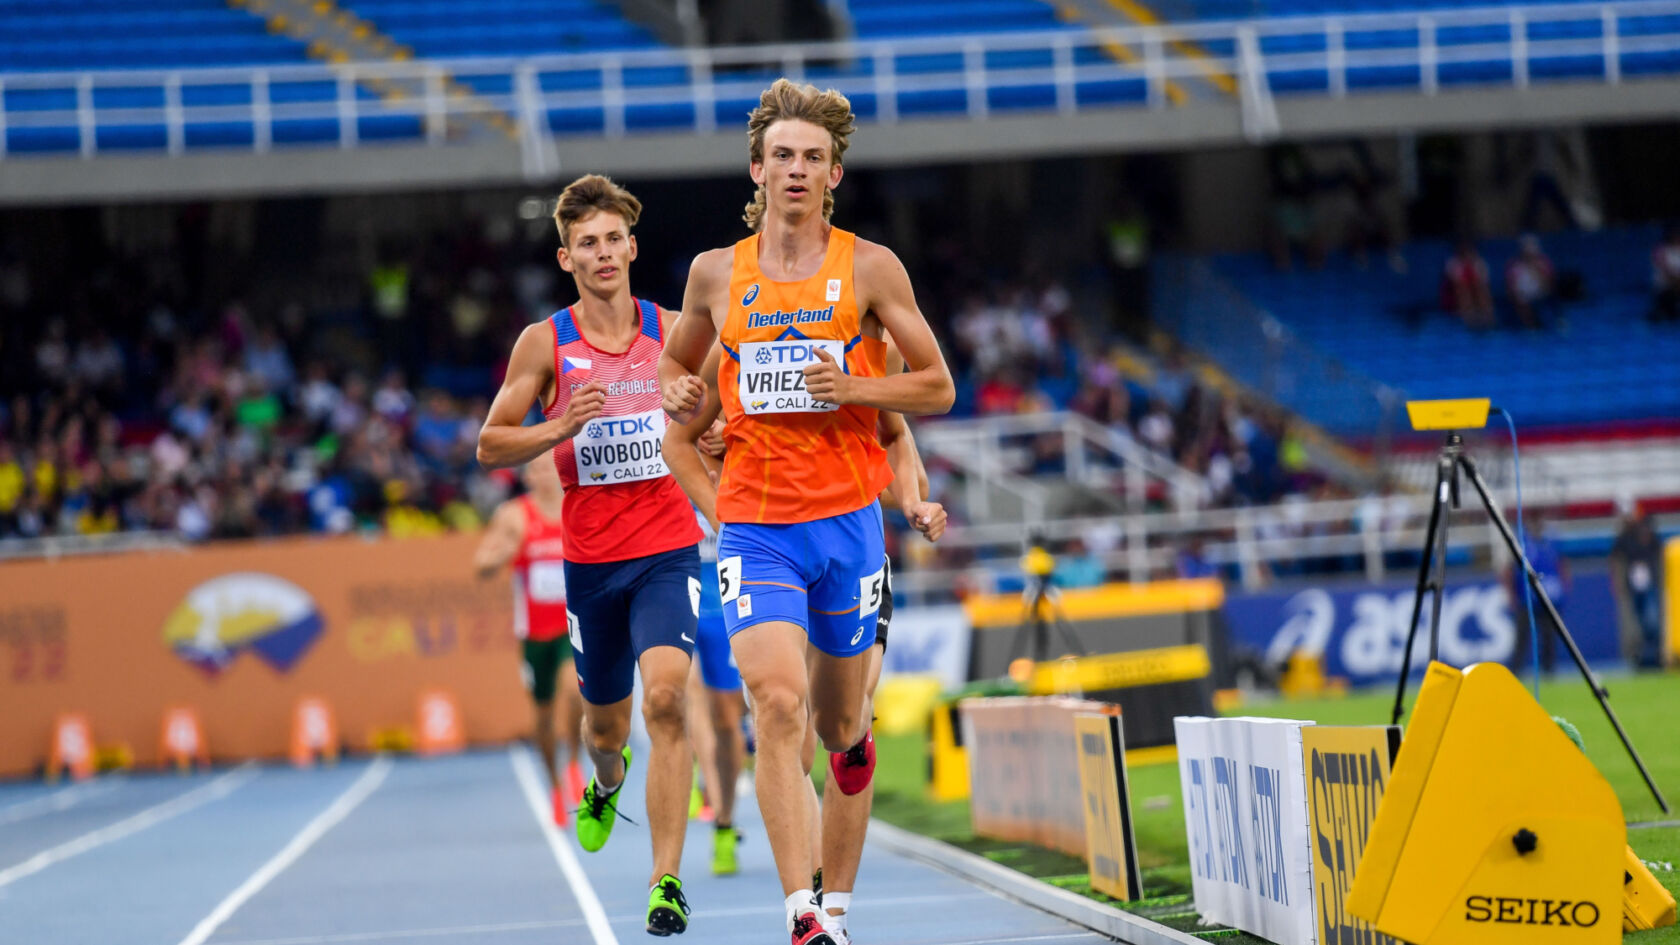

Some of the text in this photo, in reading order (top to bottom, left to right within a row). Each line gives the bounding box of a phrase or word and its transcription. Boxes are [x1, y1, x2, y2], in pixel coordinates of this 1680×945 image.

[747, 305, 834, 329] Nederland
[772, 344, 828, 363] TDK
[608, 380, 657, 396] REPUBLIC
[775, 397, 806, 409] CALI
[601, 415, 654, 437] TDK
[580, 437, 662, 467] SVOBODA
[614, 463, 663, 480] CALI 22
[720, 567, 730, 597] 5
[869, 578, 881, 608] 5
[1466, 895, 1600, 928] SEIKO
